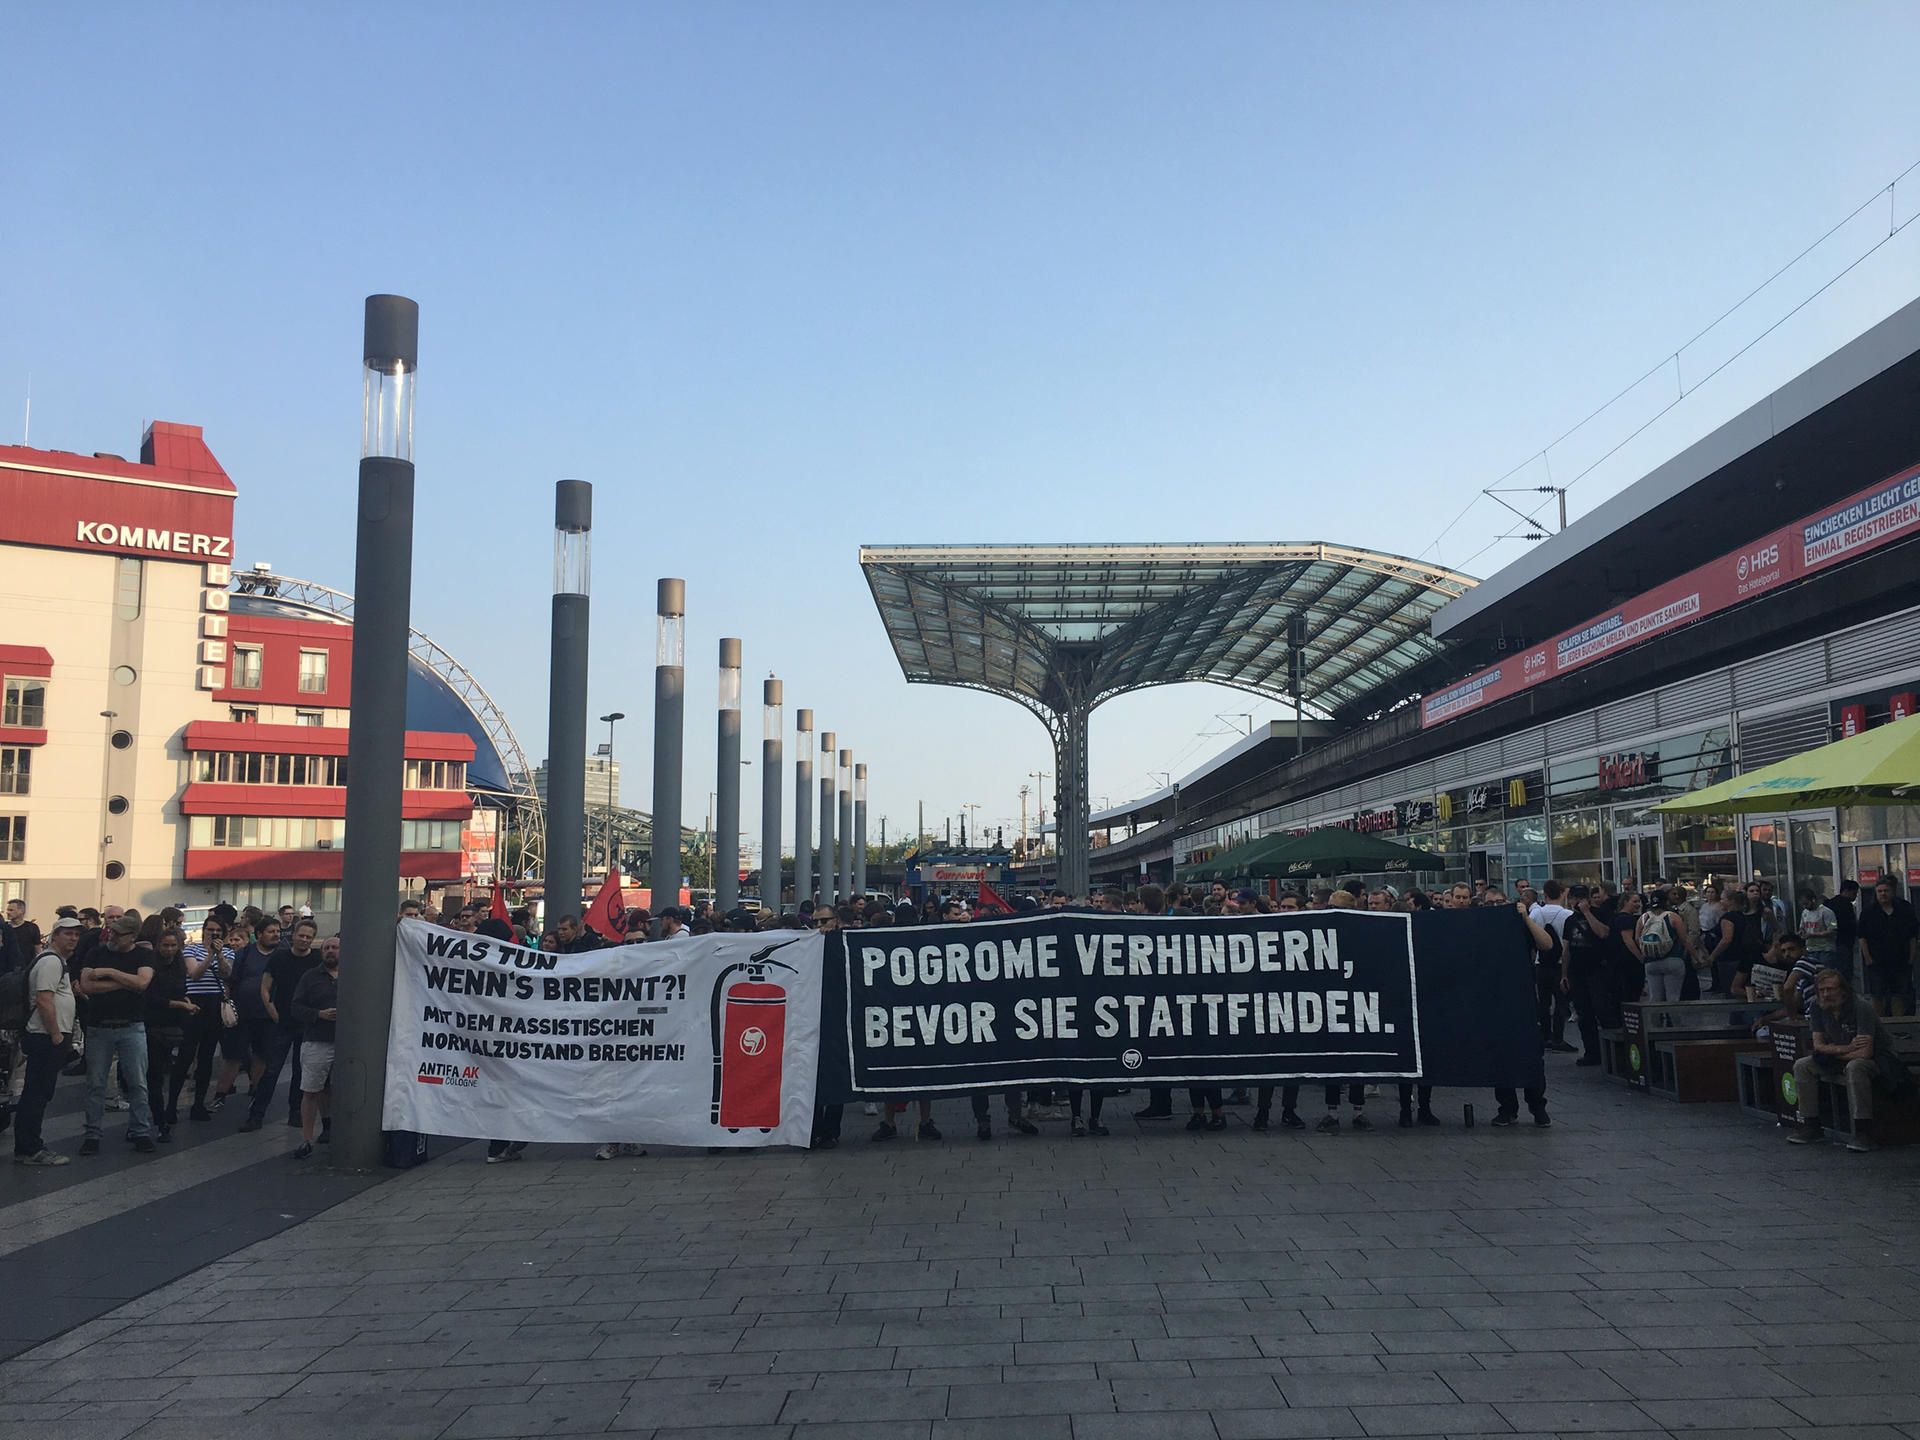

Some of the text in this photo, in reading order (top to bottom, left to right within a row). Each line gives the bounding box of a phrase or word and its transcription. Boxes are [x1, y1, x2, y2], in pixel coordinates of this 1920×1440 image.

[1805, 503, 1864, 543] EINCHECKEN
[1865, 486, 1901, 517] LEICHT
[76, 521, 231, 557] KOMMERZ
[1806, 536, 1842, 562] EINMAL
[1751, 544, 1779, 572] HRS
[206, 563, 229, 688] HOTEL
[1627, 623, 1639, 638] UND
[1640, 614, 1664, 633] PUNKTE
[1664, 597, 1699, 622] SAMMELN.
[1582, 630, 1590, 643] SIE
[1531, 651, 1546, 668] HRS
[1600, 752, 1644, 790] Eckert
[426, 933, 558, 971] WAS TUN
[861, 927, 1355, 988] POGROME VERHINDERN,
[423, 965, 687, 1002] WENN'S BRENNT?!
[424, 1006, 654, 1036] MIT DEM RASSISTISCHEN
[865, 989, 1397, 1049] BEVOR SIE STATTFINDEN.
[422, 1032, 686, 1062] NORMALZUSTAND BRECHEN!
[418, 1062, 480, 1079] ANTIFA AK
[445, 1076, 478, 1088] COLOGNE
